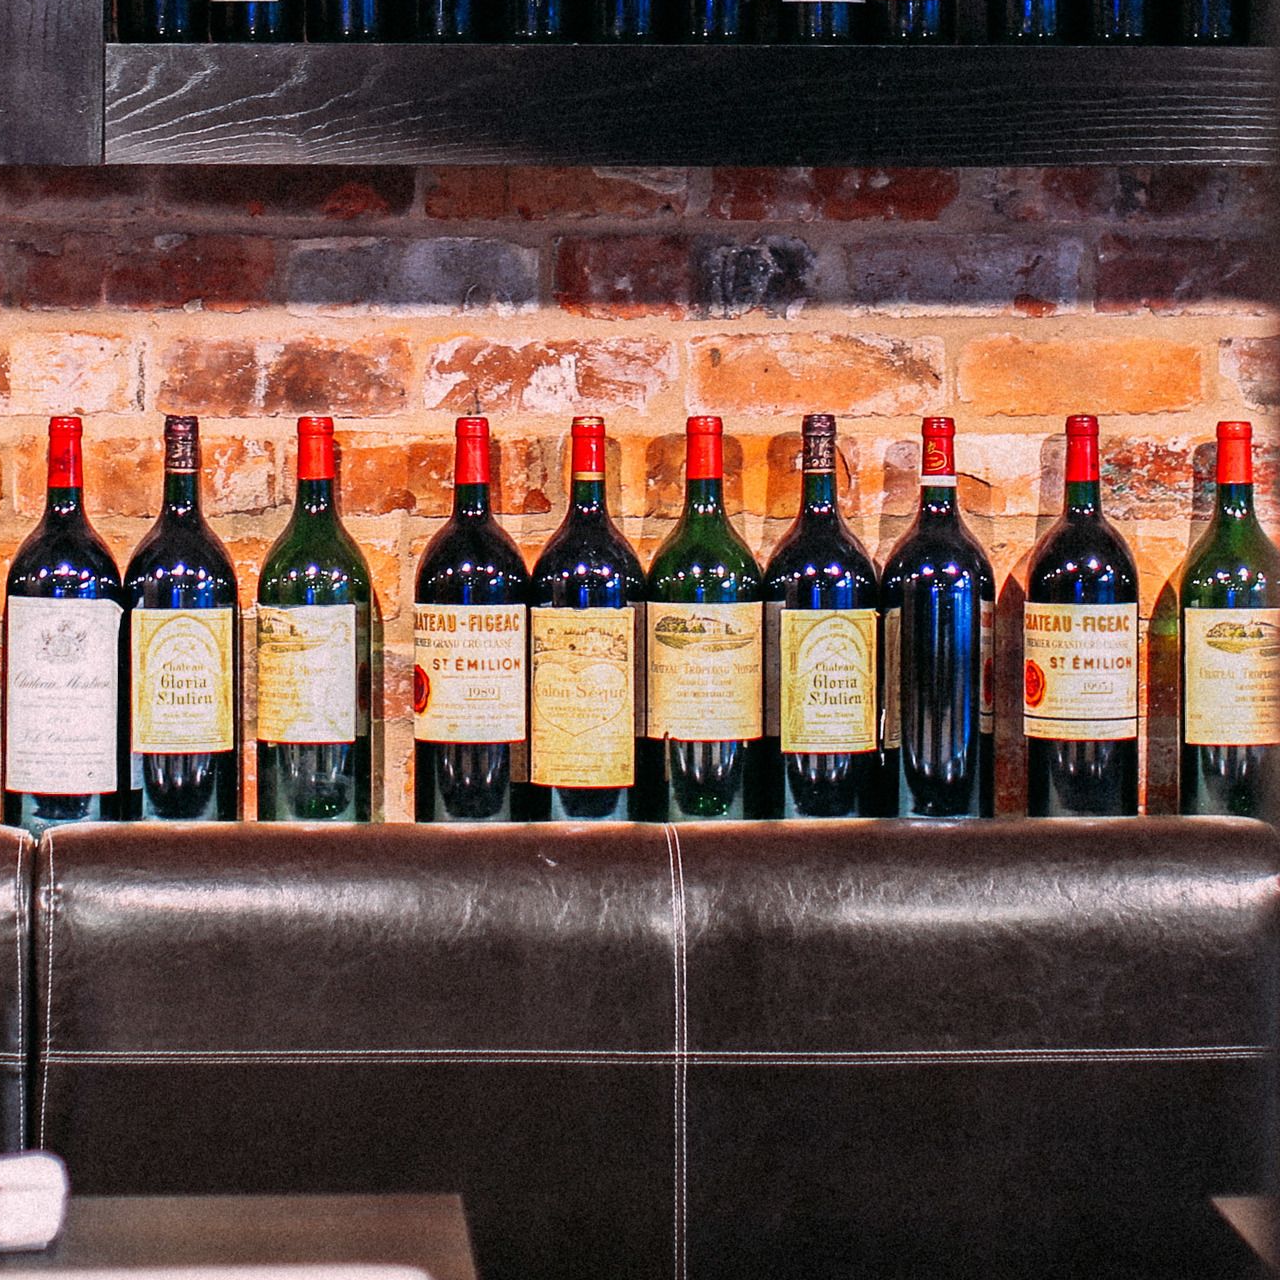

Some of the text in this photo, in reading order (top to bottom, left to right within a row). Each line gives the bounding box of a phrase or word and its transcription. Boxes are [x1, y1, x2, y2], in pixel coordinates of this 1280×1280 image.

[455, 656, 520, 671] ÉMILION
[1073, 655, 1132, 670] ÉMILION
[160, 674, 207, 689] Gloria
[813, 673, 857, 689] Gloria
[469, 687, 496, 697] 1989
